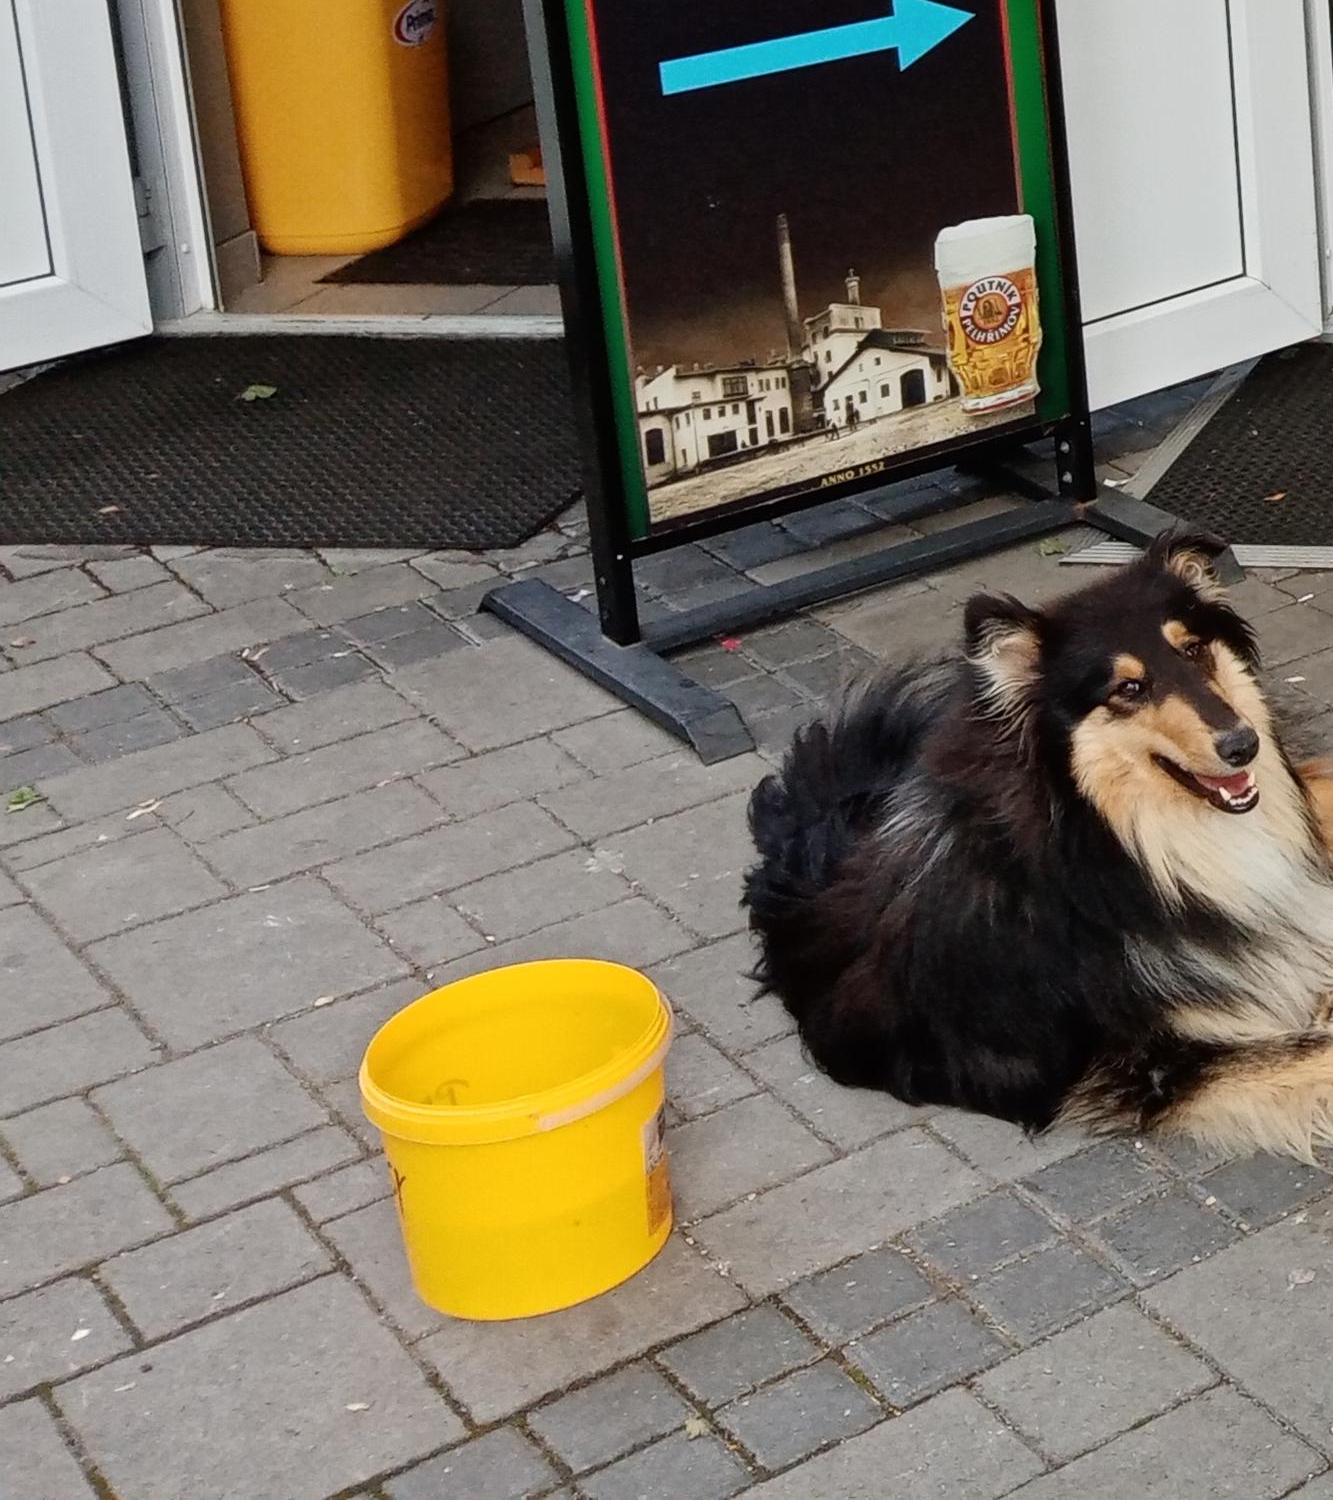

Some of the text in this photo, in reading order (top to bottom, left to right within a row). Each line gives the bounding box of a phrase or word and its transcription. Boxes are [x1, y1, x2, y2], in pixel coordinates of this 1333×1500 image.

[962, 279, 1018, 313] POUTNÍK
[961, 306, 1020, 343] PELHŘIMOV
[820, 461, 886, 488] ANNO 1552
